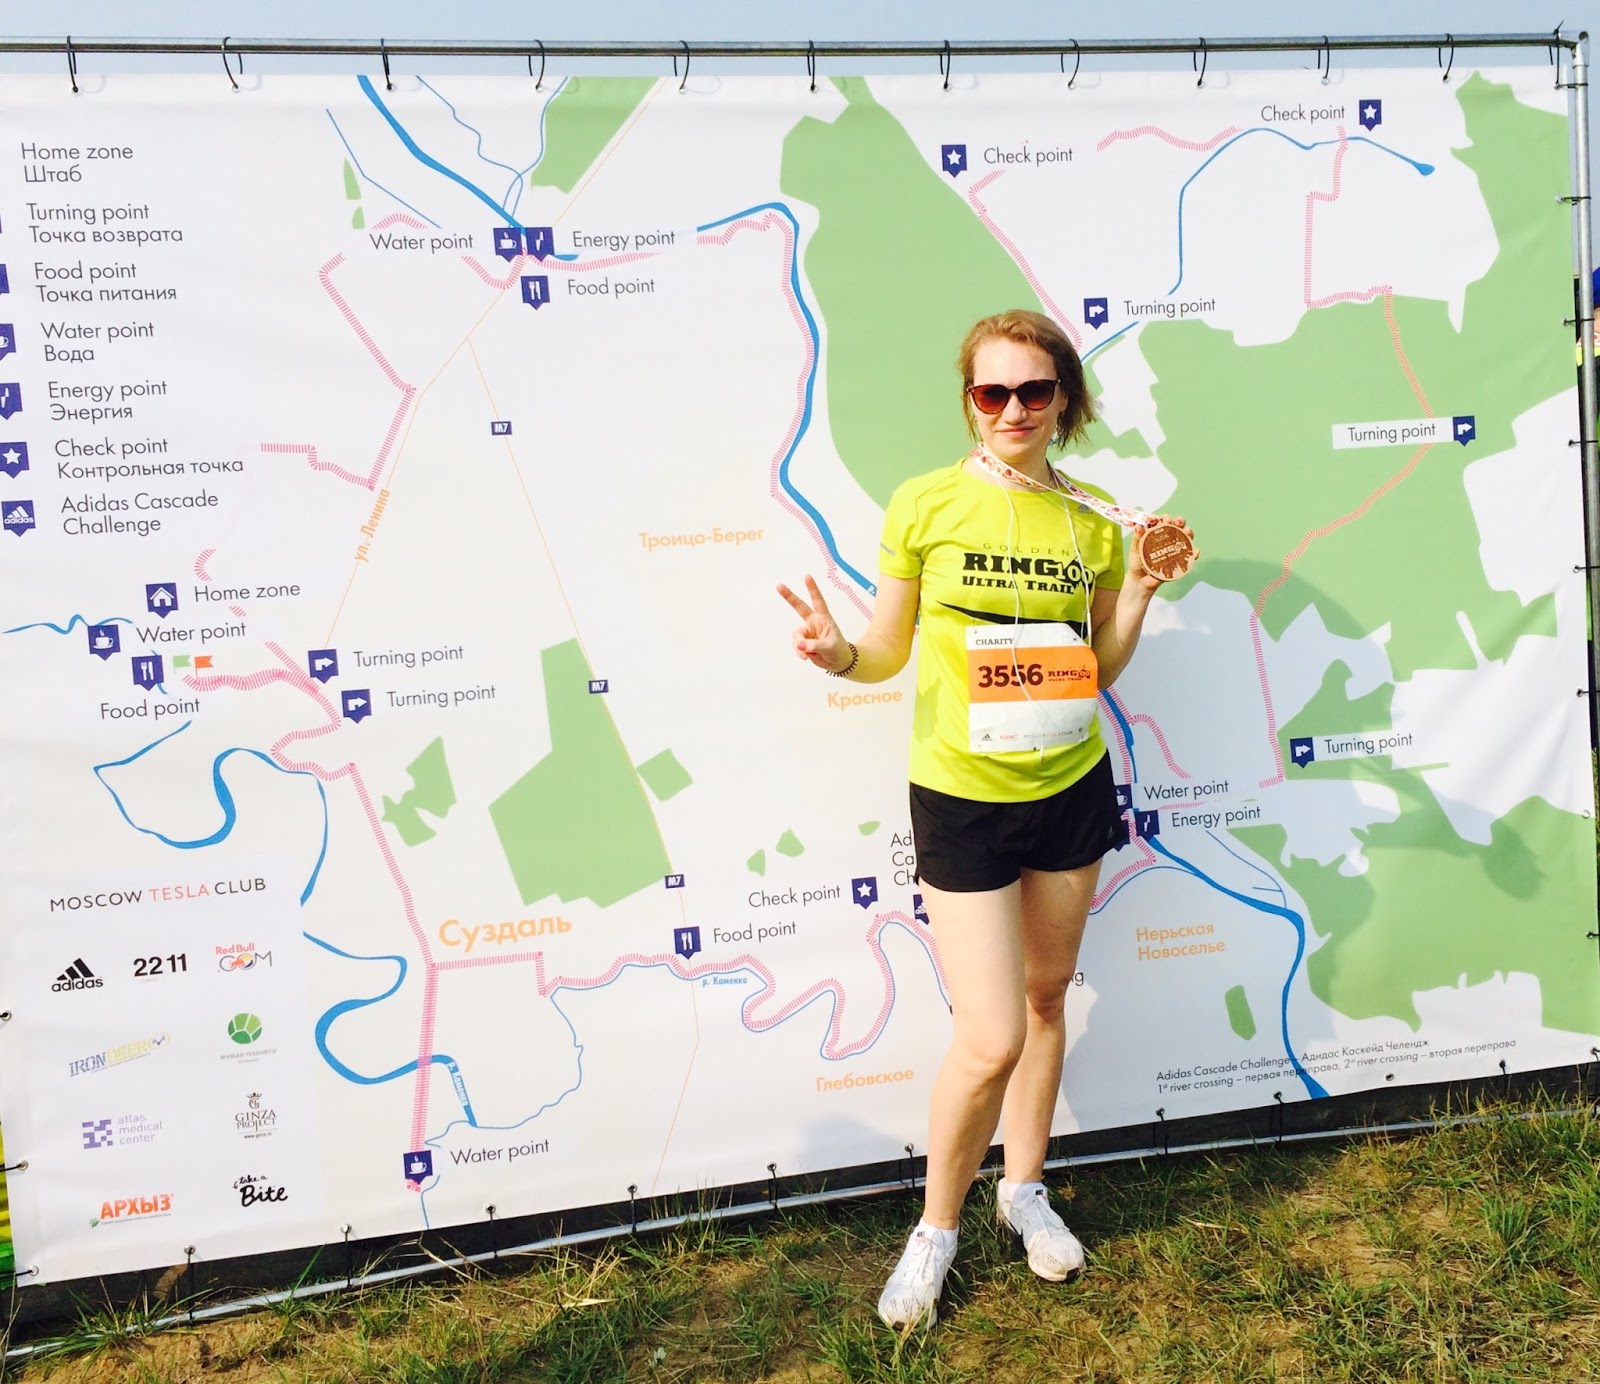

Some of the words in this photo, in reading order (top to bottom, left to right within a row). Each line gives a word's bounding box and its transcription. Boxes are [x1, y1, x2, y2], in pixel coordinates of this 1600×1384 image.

[1261, 103, 1306, 122] Check
[1310, 105, 1345, 126] point
[21, 142, 80, 160] Home
[87, 146, 133, 159] zone
[983, 142, 1032, 164] Check
[1036, 147, 1073, 168] point
[24, 164, 82, 183] Штаб
[26, 203, 96, 225] Turning
[103, 203, 149, 224] point
[29, 225, 86, 243] Точка
[92, 229, 183, 247] возврата
[370, 233, 427, 251] Water
[431, 233, 473, 257] point
[573, 231, 628, 251] Energy
[634, 231, 675, 253] point
[34, 260, 83, 280] Food
[89, 263, 136, 284] point
[36, 285, 93, 302] Точка
[99, 287, 177, 301] питания
[568, 277, 609, 296] Food
[614, 278, 655, 299] point
[1124, 300, 1175, 319] Turning
[1180, 298, 1216, 320] point
[40, 321, 101, 339] Water
[107, 322, 154, 343] point
[44, 344, 95, 363] Вода
[48, 381, 114, 402] Energy
[120, 380, 167, 401] point
[50, 404, 133, 425] Энергия
[1348, 427, 1397, 443] Turning
[1402, 423, 1436, 442] point
[54, 437, 115, 457] Check
[122, 438, 168, 460] point
[57, 461, 185, 482] Контрольная
[190, 459, 244, 475] точка
[60, 493, 129, 514] Adidas
[134, 489, 219, 511] Cascade
[360, 488, 391, 538] Ленина
[63, 515, 161, 537] Challenge
[639, 527, 765, 552] Троица-Берег
[983, 543, 1069, 556] GOLDEN
[354, 543, 371, 562] ул.
[194, 584, 250, 602] Home
[256, 583, 301, 599] zone
[962, 576, 1018, 590] ULTRA
[1025, 580, 1074, 595] TRAIL
[136, 626, 195, 644] Water
[200, 622, 246, 644] point
[975, 638, 1014, 646] CHARITY
[353, 650, 416, 669] Turning
[421, 645, 464, 667] point
[978, 663, 1044, 688] 3556
[386, 690, 448, 708] Turning
[454, 685, 496, 706] point
[828, 691, 902, 711] Красное
[101, 699, 148, 720] Food
[154, 698, 200, 721] point
[1325, 738, 1374, 754] Turning
[1379, 733, 1412, 753] point
[1143, 785, 1189, 800] Water
[1194, 780, 1229, 802] point
[1172, 810, 1220, 829] Energy
[1225, 806, 1261, 827] point
[50, 890, 142, 912] MOSCOW
[149, 883, 210, 902] TESLA
[214, 878, 266, 895] CLUB
[748, 887, 798, 908] Check
[802, 885, 841, 906] point
[438, 916, 572, 953] Суздаль
[713, 923, 753, 943] Food
[758, 921, 797, 943] point
[1136, 923, 1214, 943] Нерьская
[216, 945, 235, 955] Red
[236, 942, 255, 953] Bull
[1138, 941, 1225, 961] Новоселье
[51, 976, 104, 993] adidas
[713, 976, 748, 986] Каменка
[69, 1051, 106, 1077] IRON
[1156, 1067, 1191, 1081] Adidas
[1194, 1062, 1238, 1076] Cascade
[1240, 1057, 1290, 1070] Challenge
[1301, 1050, 1339, 1062] Адидас
[1342, 1043, 1384, 1056] Каскейд
[1386, 1039, 1429, 1051] Челендж
[1170, 1081, 1191, 1093] river
[1193, 1076, 1234, 1089] crossing
[1245, 1071, 1281, 1084] первая
[1357, 1056, 1377, 1067] river
[1379, 1051, 1418, 1063] crossing
[1429, 1048, 1463, 1058] вторая
[1464, 1039, 1516, 1054] переправа
[816, 1069, 914, 1092] Глебовское
[118, 1113, 146, 1125] atlas
[235, 1109, 277, 1122] GINZA
[236, 1118, 276, 1132] PROJECT
[119, 1121, 163, 1135] medical
[120, 1133, 156, 1145] center
[450, 1146, 503, 1166] Water
[508, 1139, 550, 1161] point
[101, 1193, 171, 1220] АРХЫЗ
[239, 1185, 288, 1207] Bite
